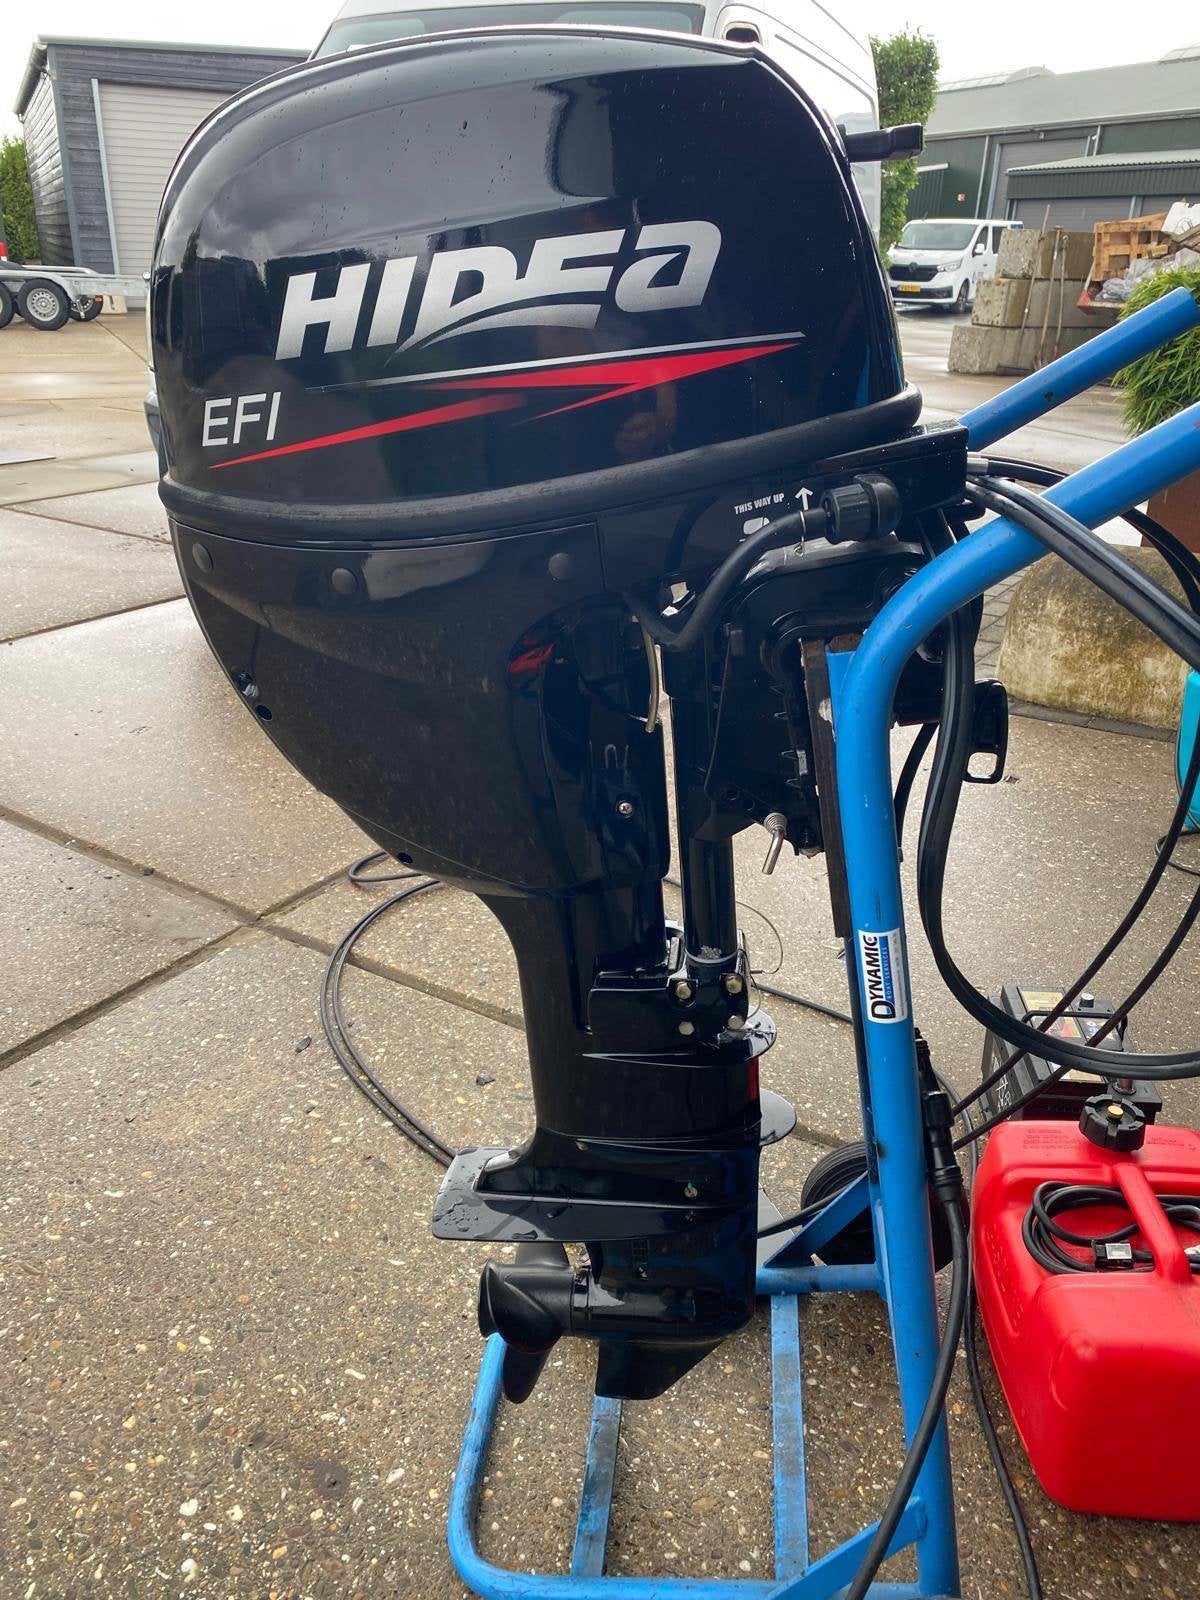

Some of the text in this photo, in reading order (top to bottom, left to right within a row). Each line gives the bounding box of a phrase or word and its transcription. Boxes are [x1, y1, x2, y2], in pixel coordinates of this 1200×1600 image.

[202, 392, 282, 447] EFI
[734, 493, 784, 515] THIS WAY UP
[863, 935, 896, 1019] DYNAMIC
[882, 946, 891, 979] SERVICES
